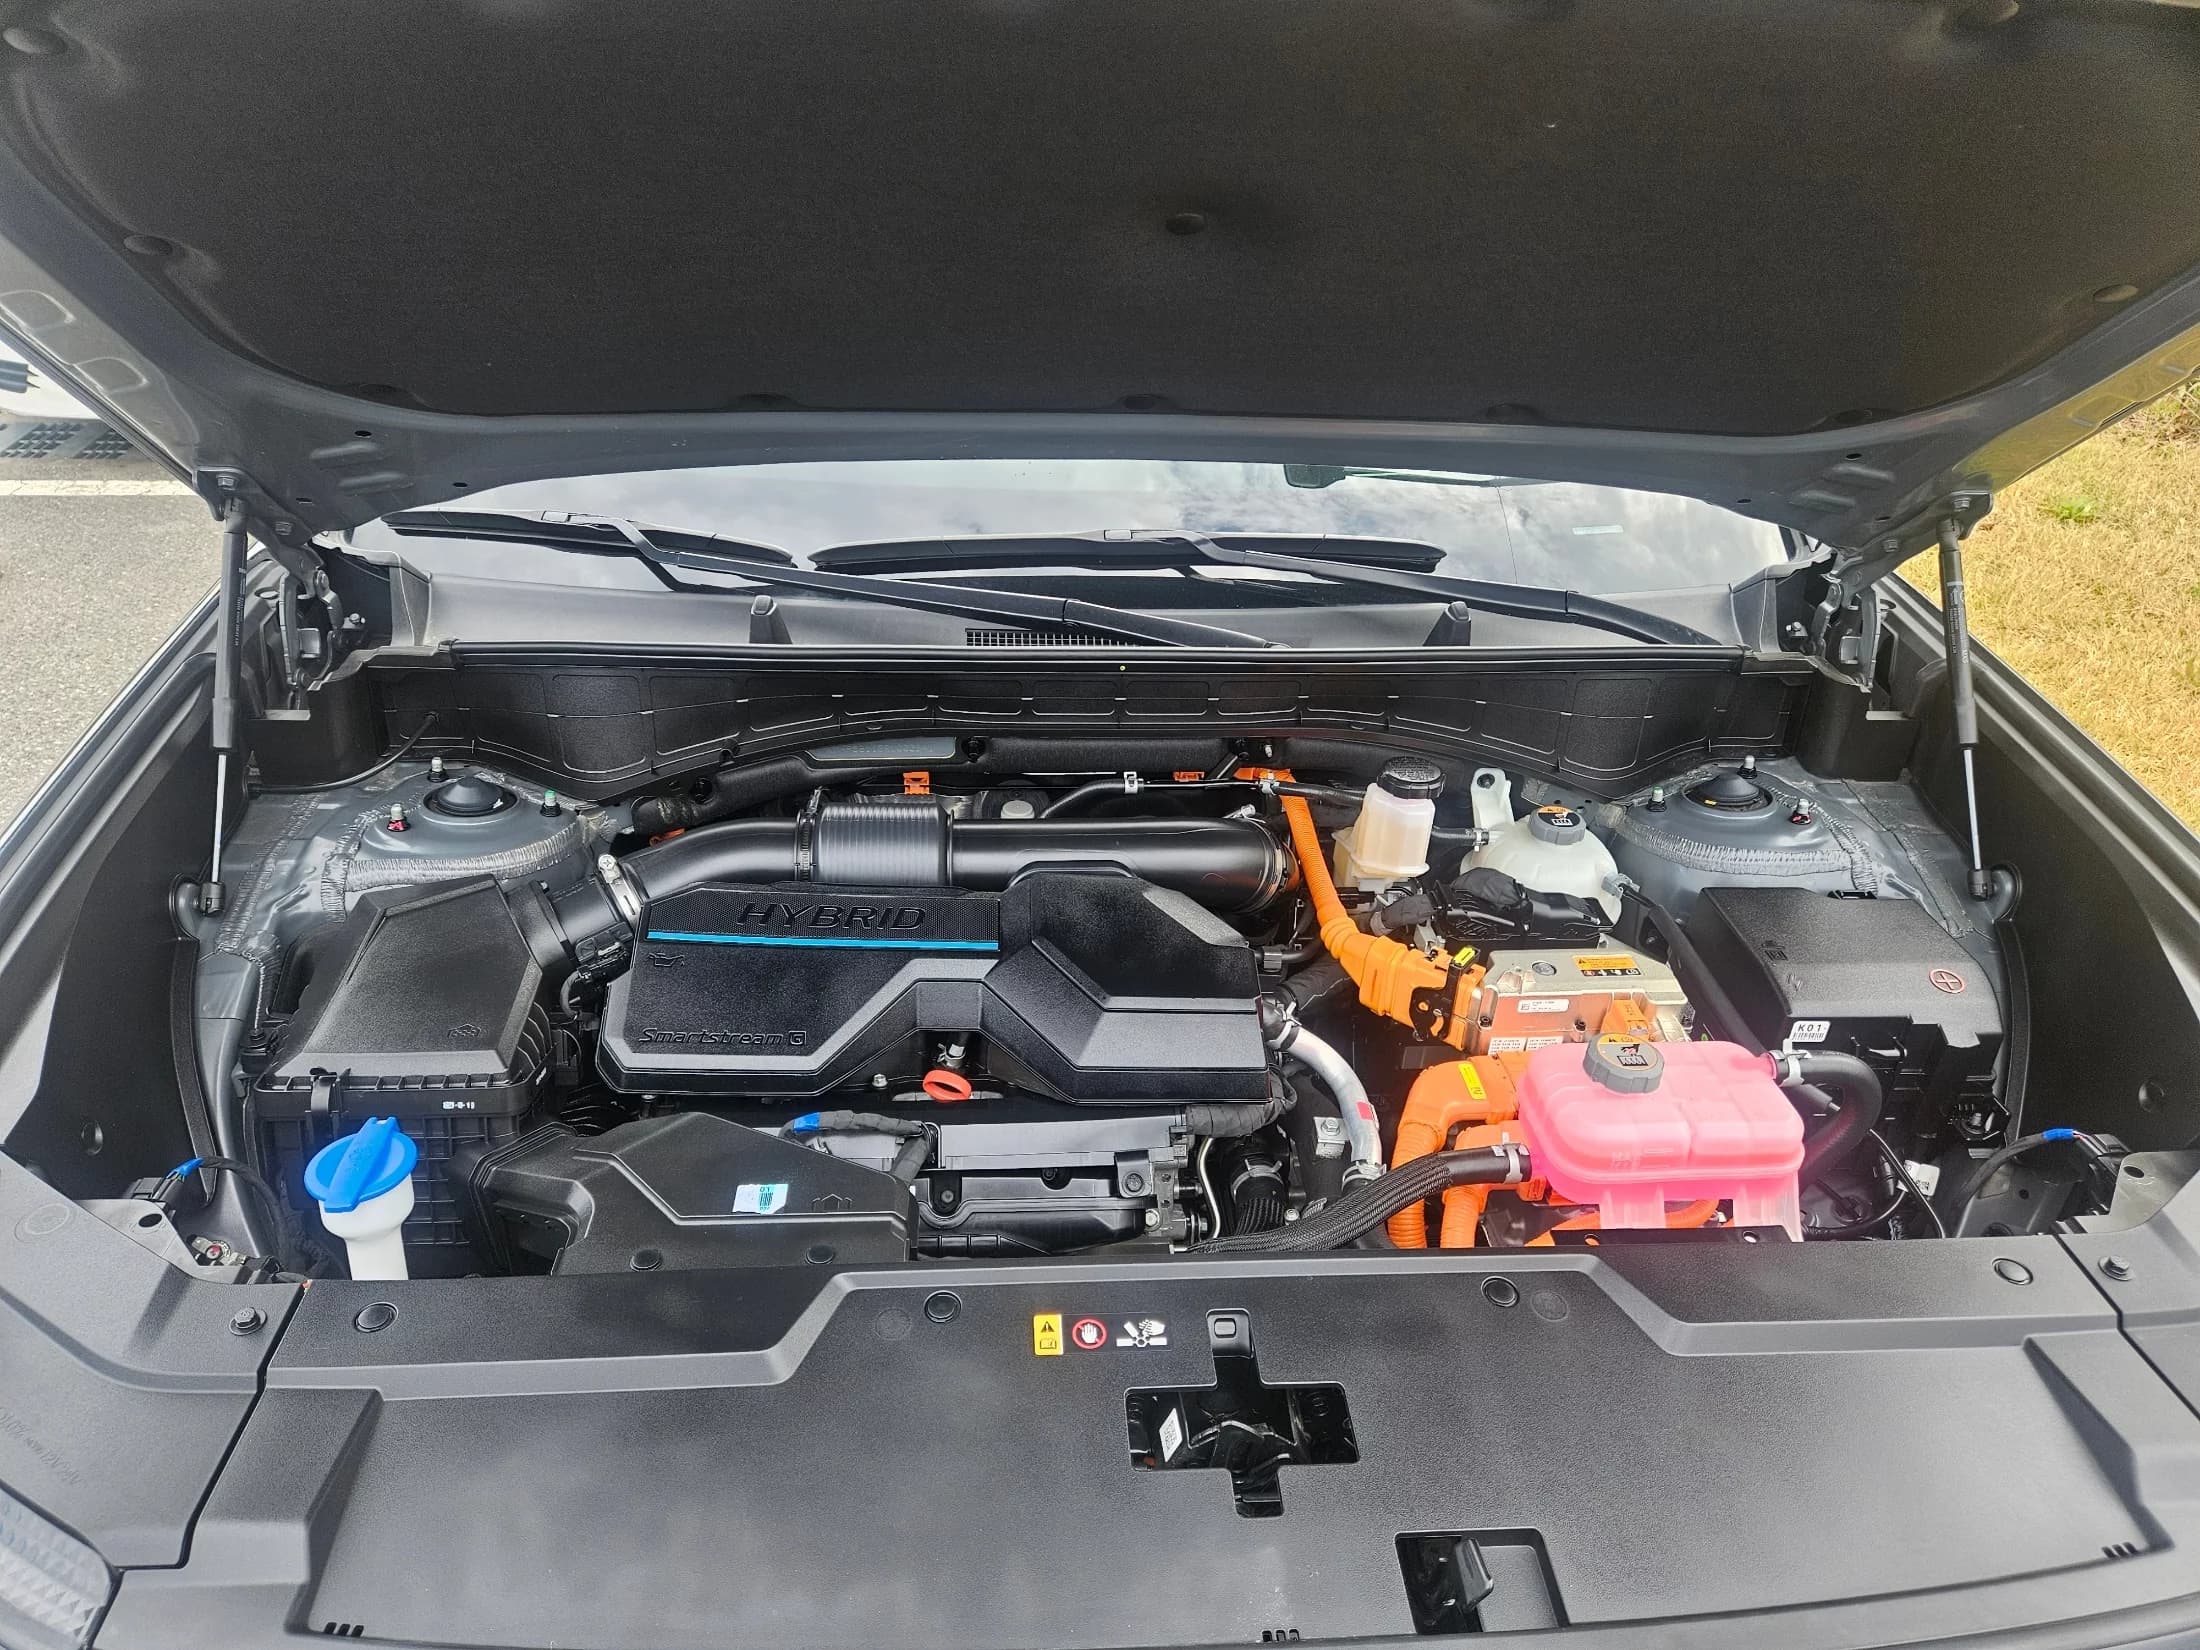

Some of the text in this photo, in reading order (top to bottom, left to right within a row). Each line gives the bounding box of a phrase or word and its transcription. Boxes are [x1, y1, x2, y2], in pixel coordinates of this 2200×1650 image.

[736, 901, 926, 930] HYBRID
[639, 1027, 807, 1046] Smartstream G
